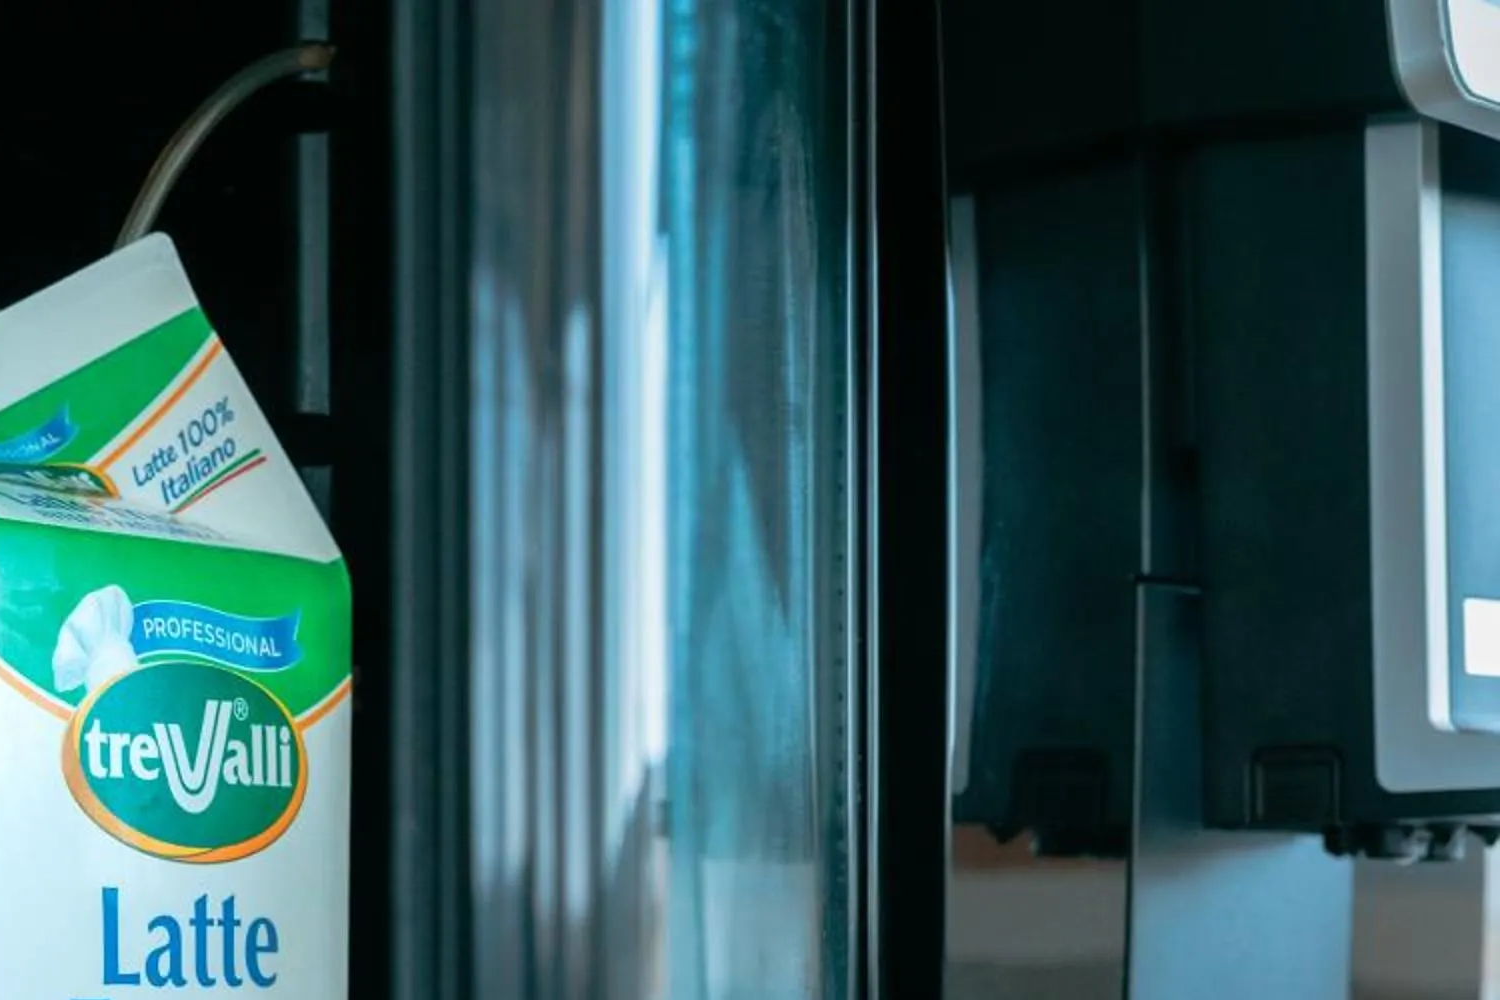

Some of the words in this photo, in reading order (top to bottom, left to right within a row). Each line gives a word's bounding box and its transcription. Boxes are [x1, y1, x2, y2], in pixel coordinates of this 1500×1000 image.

[132, 445, 178, 487] Latte
[177, 396, 234, 455] 100%
[160, 437, 236, 505] Italiano
[143, 617, 282, 657] PROFESSIONAL
[102, 886, 279, 988] Latte
